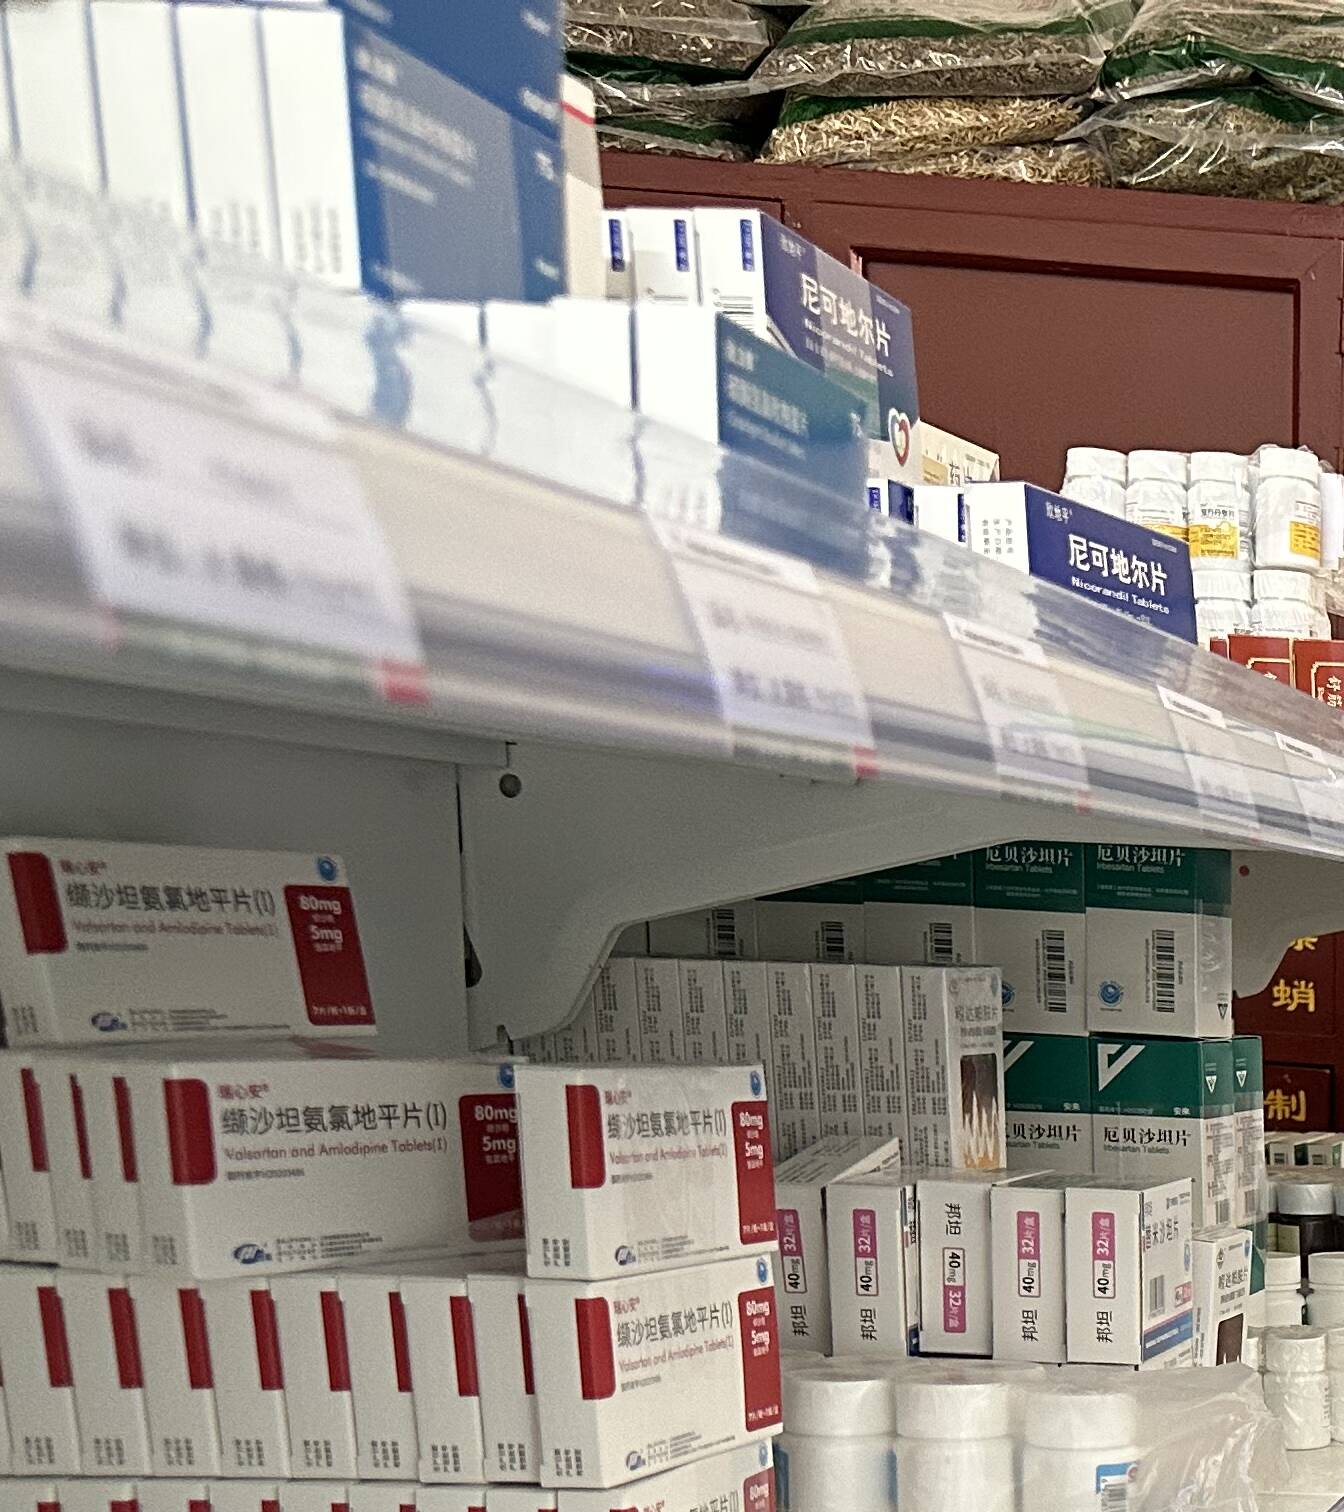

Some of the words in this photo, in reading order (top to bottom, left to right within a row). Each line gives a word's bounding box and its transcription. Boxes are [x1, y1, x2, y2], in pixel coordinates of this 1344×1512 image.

[801, 273, 892, 358] 尼可地尔片
[1068, 534, 1168, 596] 尼可地尔片
[1263, 1088, 1307, 1122] 制
[1103, 1126, 1191, 1147] 厄贝沙坦片
[945, 1202, 962, 1236] 邦坦
[788, 1258, 802, 1290] 40mg
[860, 1260, 875, 1292] 40mg
[946, 1252, 961, 1284] 40mg
[1022, 1261, 1037, 1294] 40mg
[1097, 1262, 1112, 1295] 40mg
[793, 1305, 809, 1337] 邦坦
[860, 1308, 877, 1342] 邦坦
[1021, 1309, 1038, 1342] 邦坦
[1096, 1310, 1113, 1343] 邦坦
